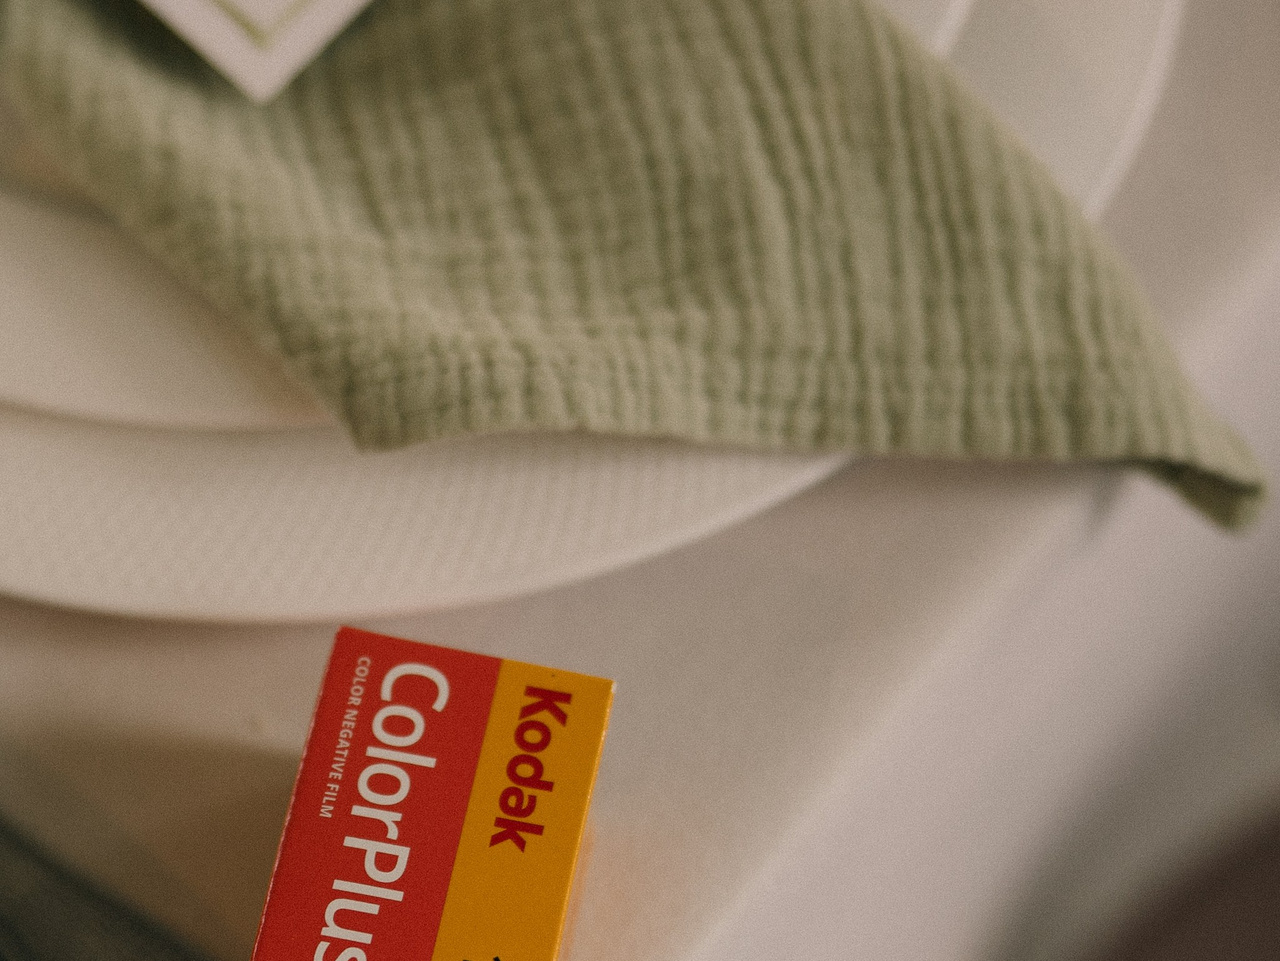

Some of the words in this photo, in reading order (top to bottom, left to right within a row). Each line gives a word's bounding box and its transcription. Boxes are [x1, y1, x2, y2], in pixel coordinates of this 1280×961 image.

[347, 656, 371, 706] COLOR
[328, 709, 358, 780] NEGATIVE
[489, 685, 572, 853] Kodak
[319, 783, 340, 818] FILM
